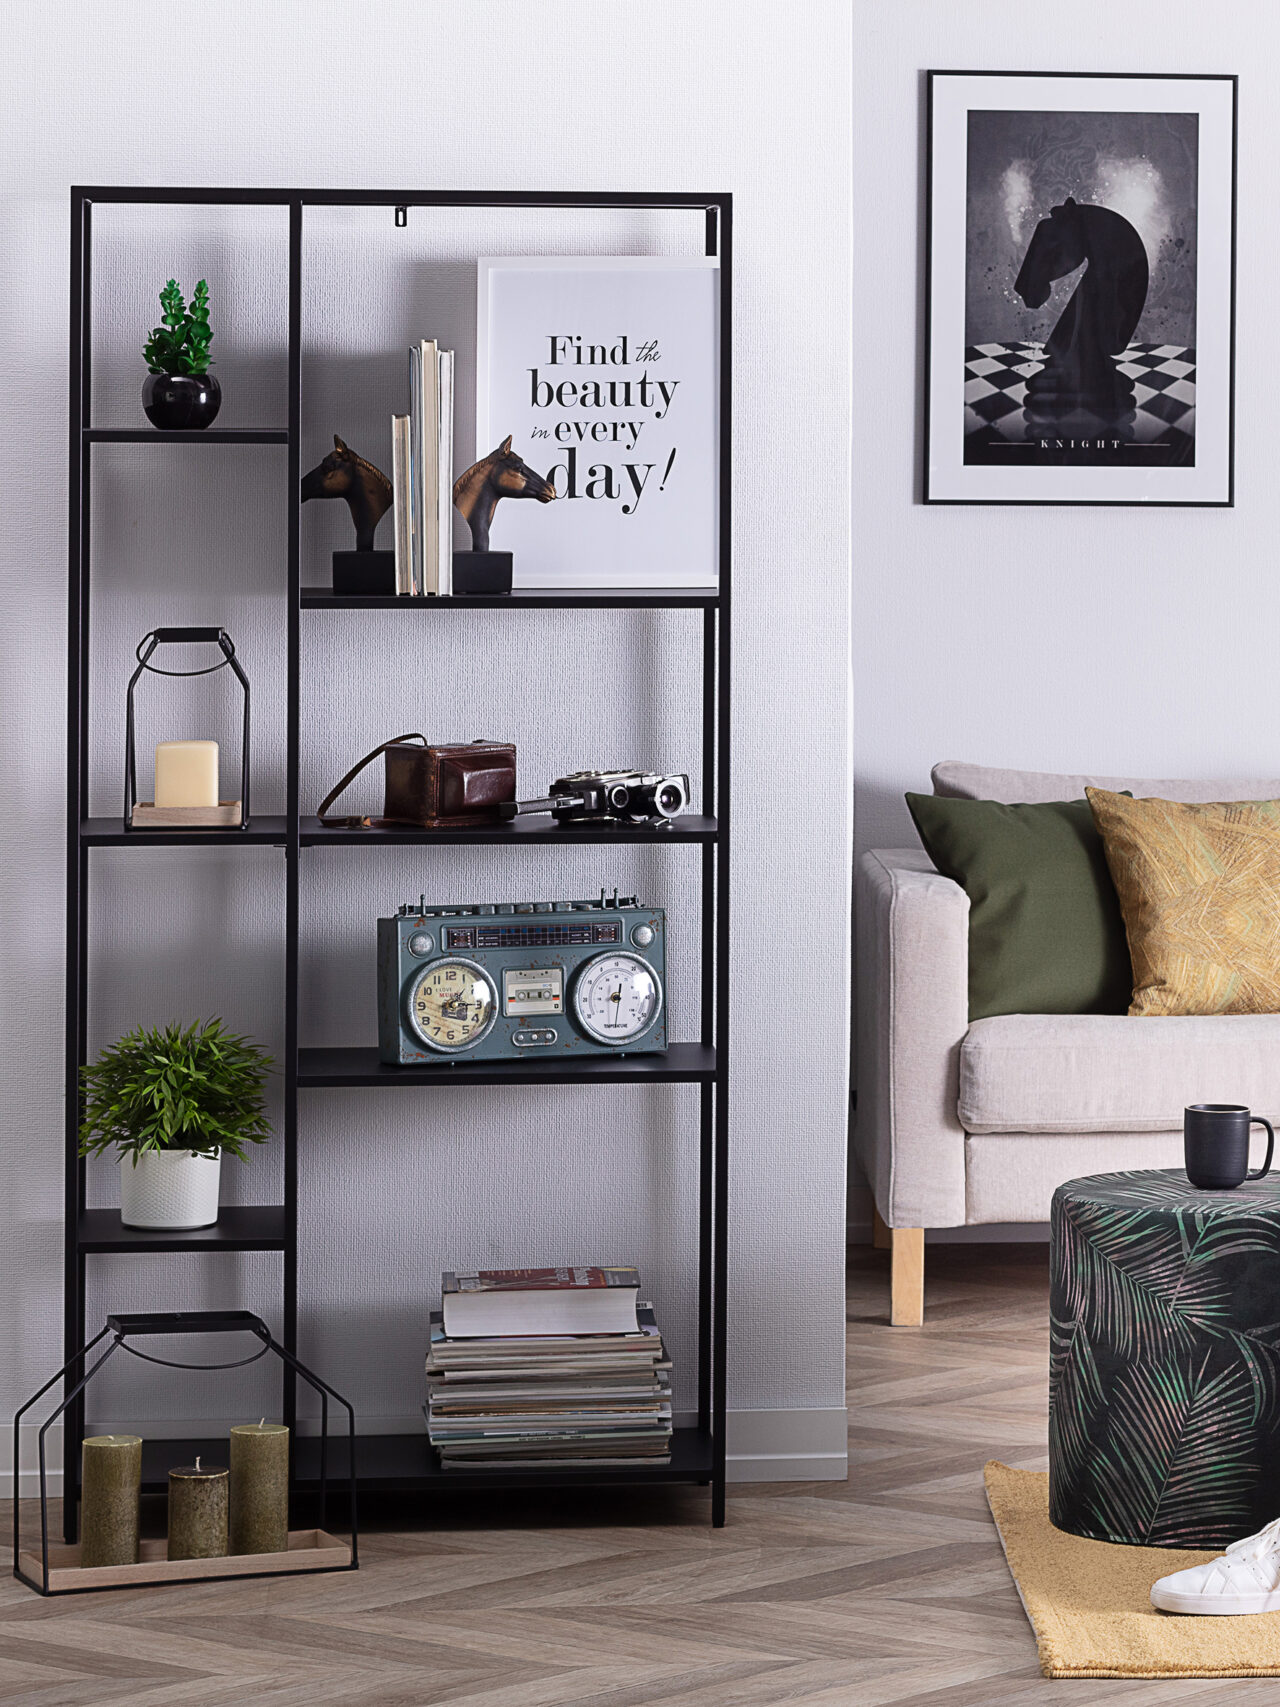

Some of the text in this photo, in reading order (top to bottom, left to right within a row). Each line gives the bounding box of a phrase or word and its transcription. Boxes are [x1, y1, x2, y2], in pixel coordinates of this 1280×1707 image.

[546, 336, 662, 365] Find the
[526, 368, 680, 419] beauty
[531, 421, 646, 450] in every
[1041, 439, 1120, 449] KNIGHT
[546, 447, 677, 515] day!
[433, 975, 441, 985] 11
[445, 971, 457, 981] 12
[423, 987, 433, 996] 10
[417, 1001, 426, 1011] 9
[475, 1000, 482, 1010] 3
[422, 1016, 430, 1026] 8
[471, 1013, 479, 1023] 4
[433, 1027, 441, 1036] 7
[462, 1025, 470, 1034] 5
[446, 1031, 455, 1040] 6
